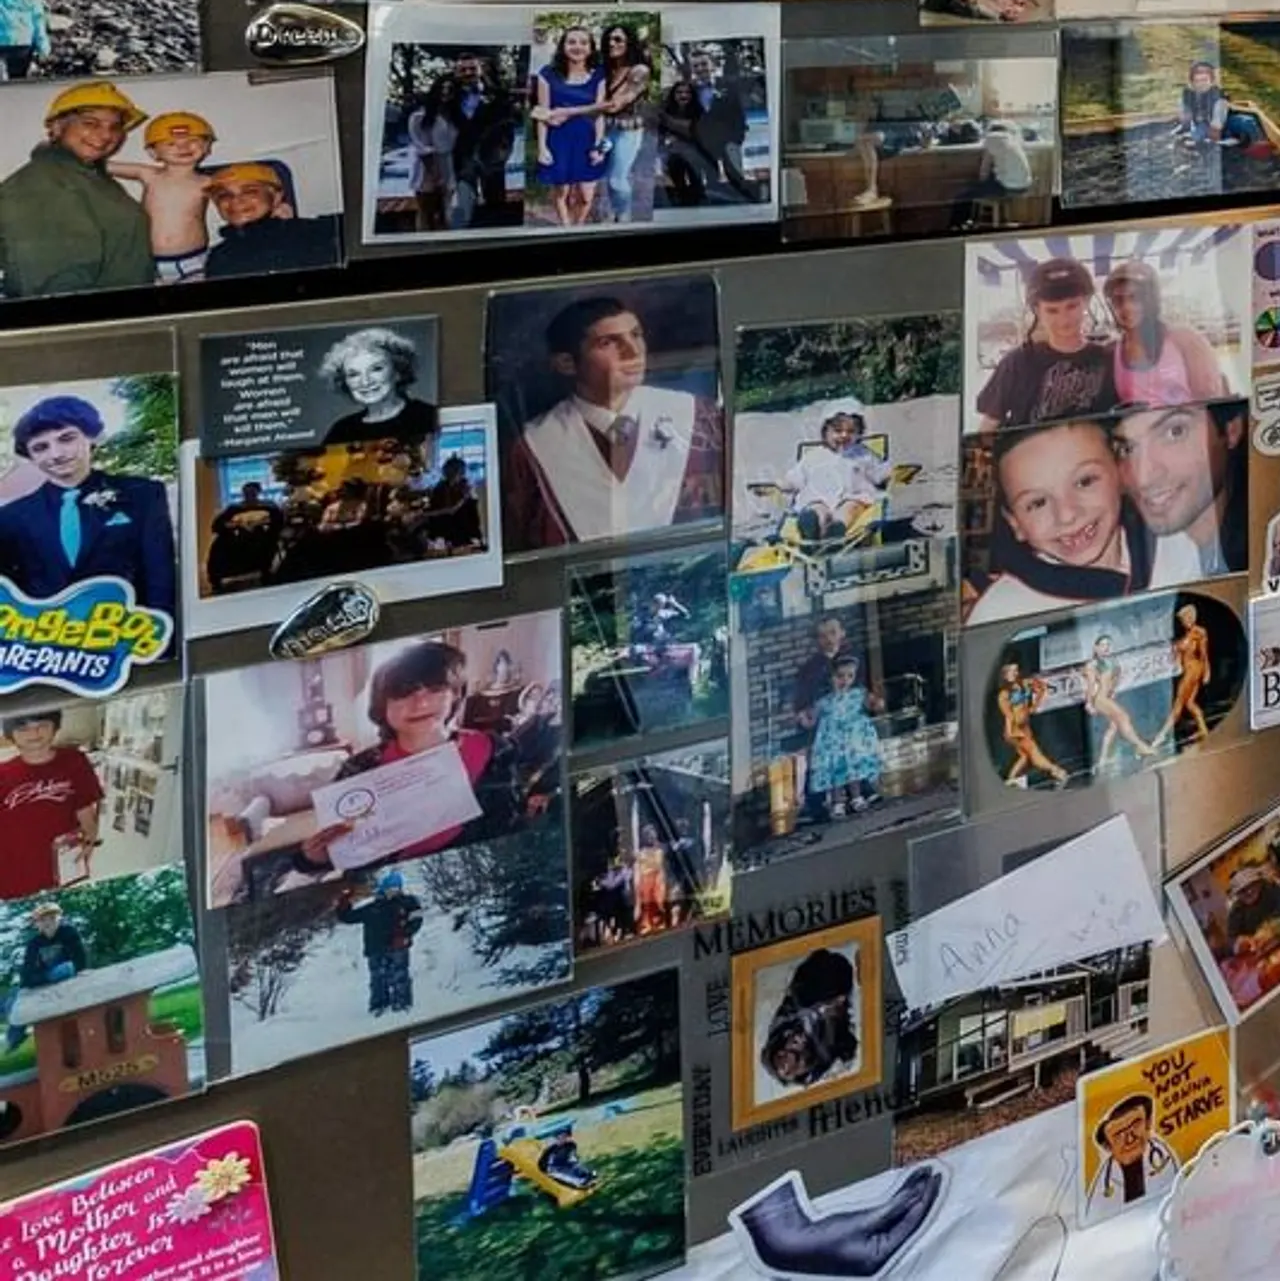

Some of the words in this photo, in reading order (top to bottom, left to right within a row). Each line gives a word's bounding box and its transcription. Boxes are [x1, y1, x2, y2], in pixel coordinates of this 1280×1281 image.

[220, 356, 240, 366] are
[243, 352, 277, 364] afraid
[280, 348, 304, 361] that
[228, 364, 273, 376] women
[276, 361, 297, 372] will
[221, 376, 255, 389] laugh
[257, 375, 270, 385] at
[239, 387, 287, 399] Women
[223, 413, 248, 424] that
[251, 411, 278, 421] men
[281, 407, 301, 418] will
[233, 402, 253, 412] are
[256, 397, 291, 410] afraid
[234, 423, 251, 434] kill
[274, 429, 316, 442] Atwood
[0, 602, 162, 657] ongeBob
[0, 644, 110, 678] REPANTS
[692, 884, 878, 962] MEMORIES
[706, 977, 731, 1038] LOVE
[1142, 1050, 1186, 1084] YOU
[1155, 1060, 1197, 1098] NOT
[1162, 1076, 1213, 1110] GONNA
[1158, 1085, 1226, 1137] STARVE
[21, 1210, 64, 1243] Love
[71, 1164, 157, 1217] Between
[11, 1257, 27, 1271] a
[36, 1201, 140, 1261] Mother
[143, 1175, 178, 1205] and
[204, 1232, 262, 1260] daughter
